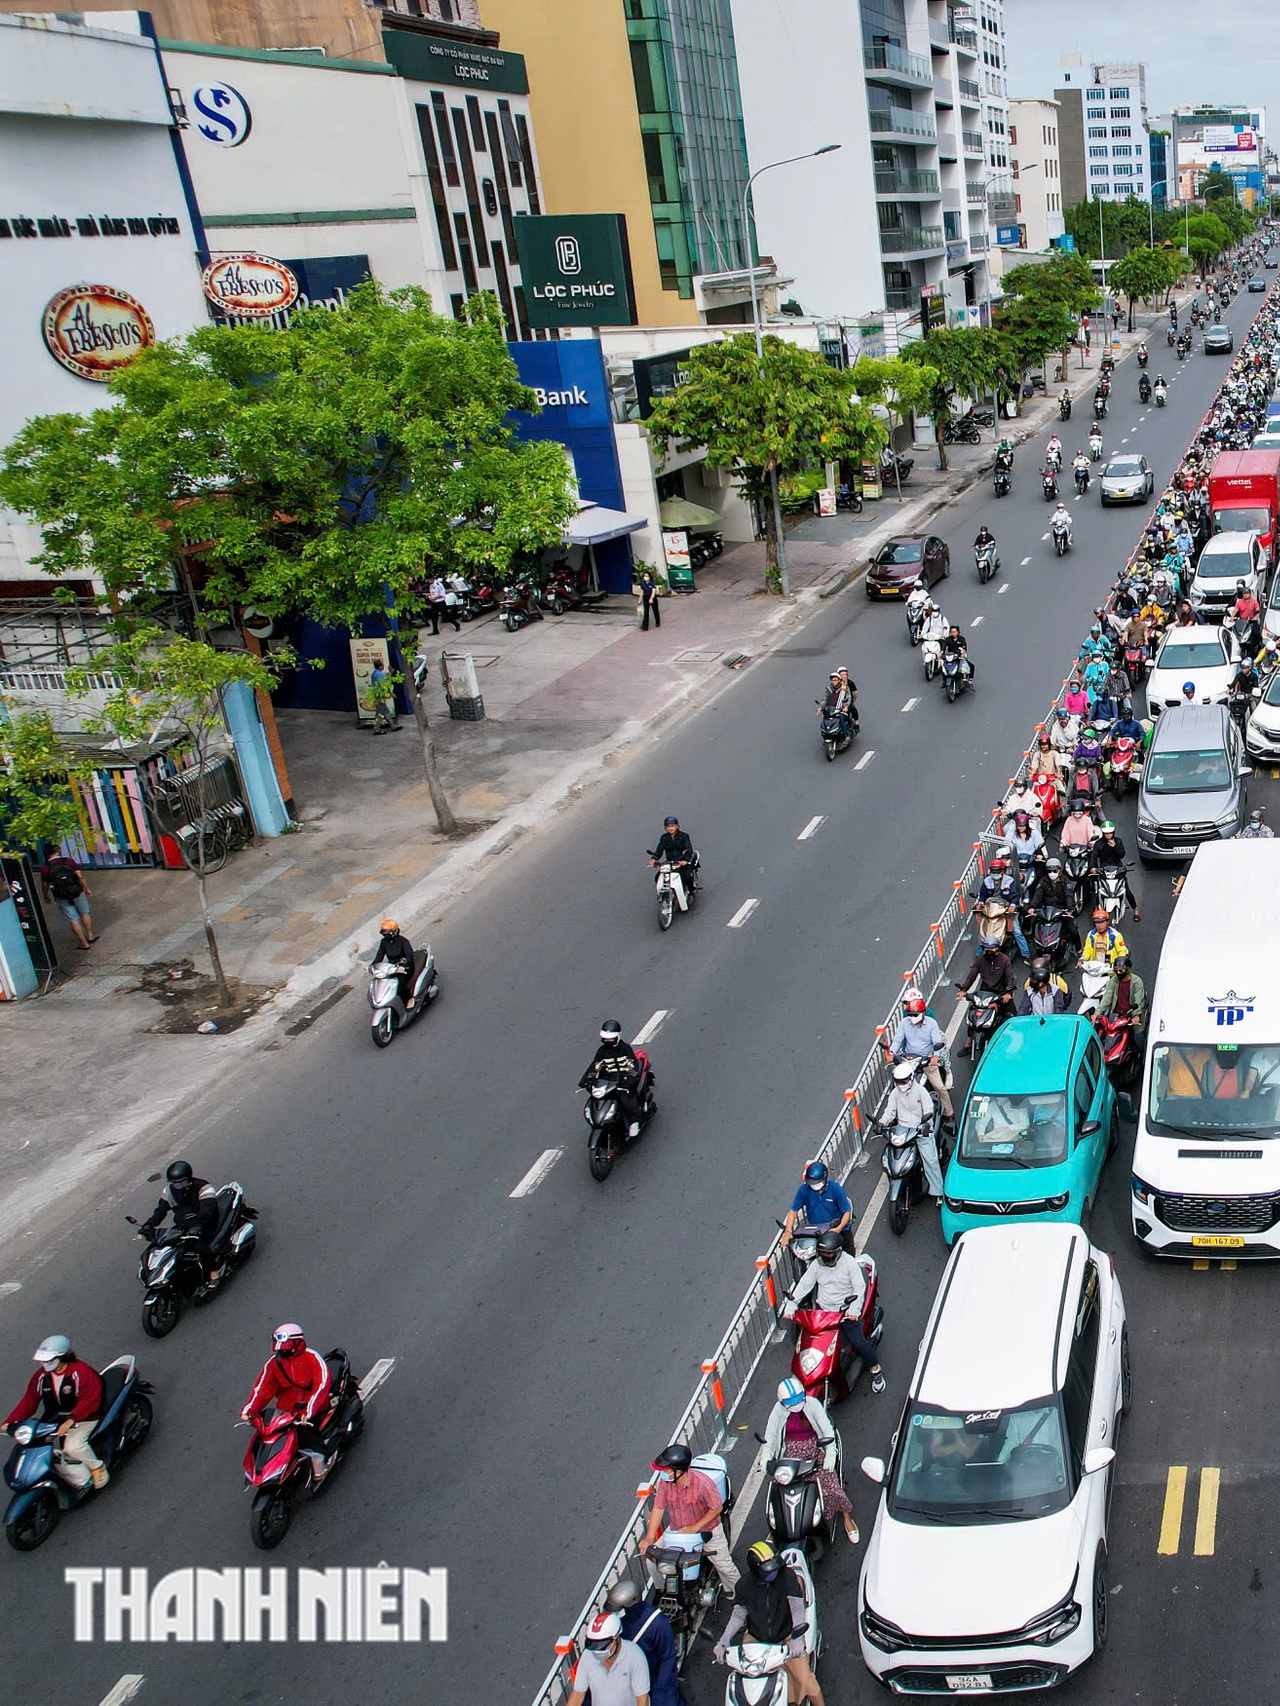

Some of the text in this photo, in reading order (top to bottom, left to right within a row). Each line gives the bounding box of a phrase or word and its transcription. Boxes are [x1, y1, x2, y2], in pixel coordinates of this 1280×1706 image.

[429, 43, 444, 56] CÔNG
[454, 62, 489, 81] LỘC PHÚC
[533, 280, 616, 301] LỘC PHÚC
[536, 385, 589, 406] Bank
